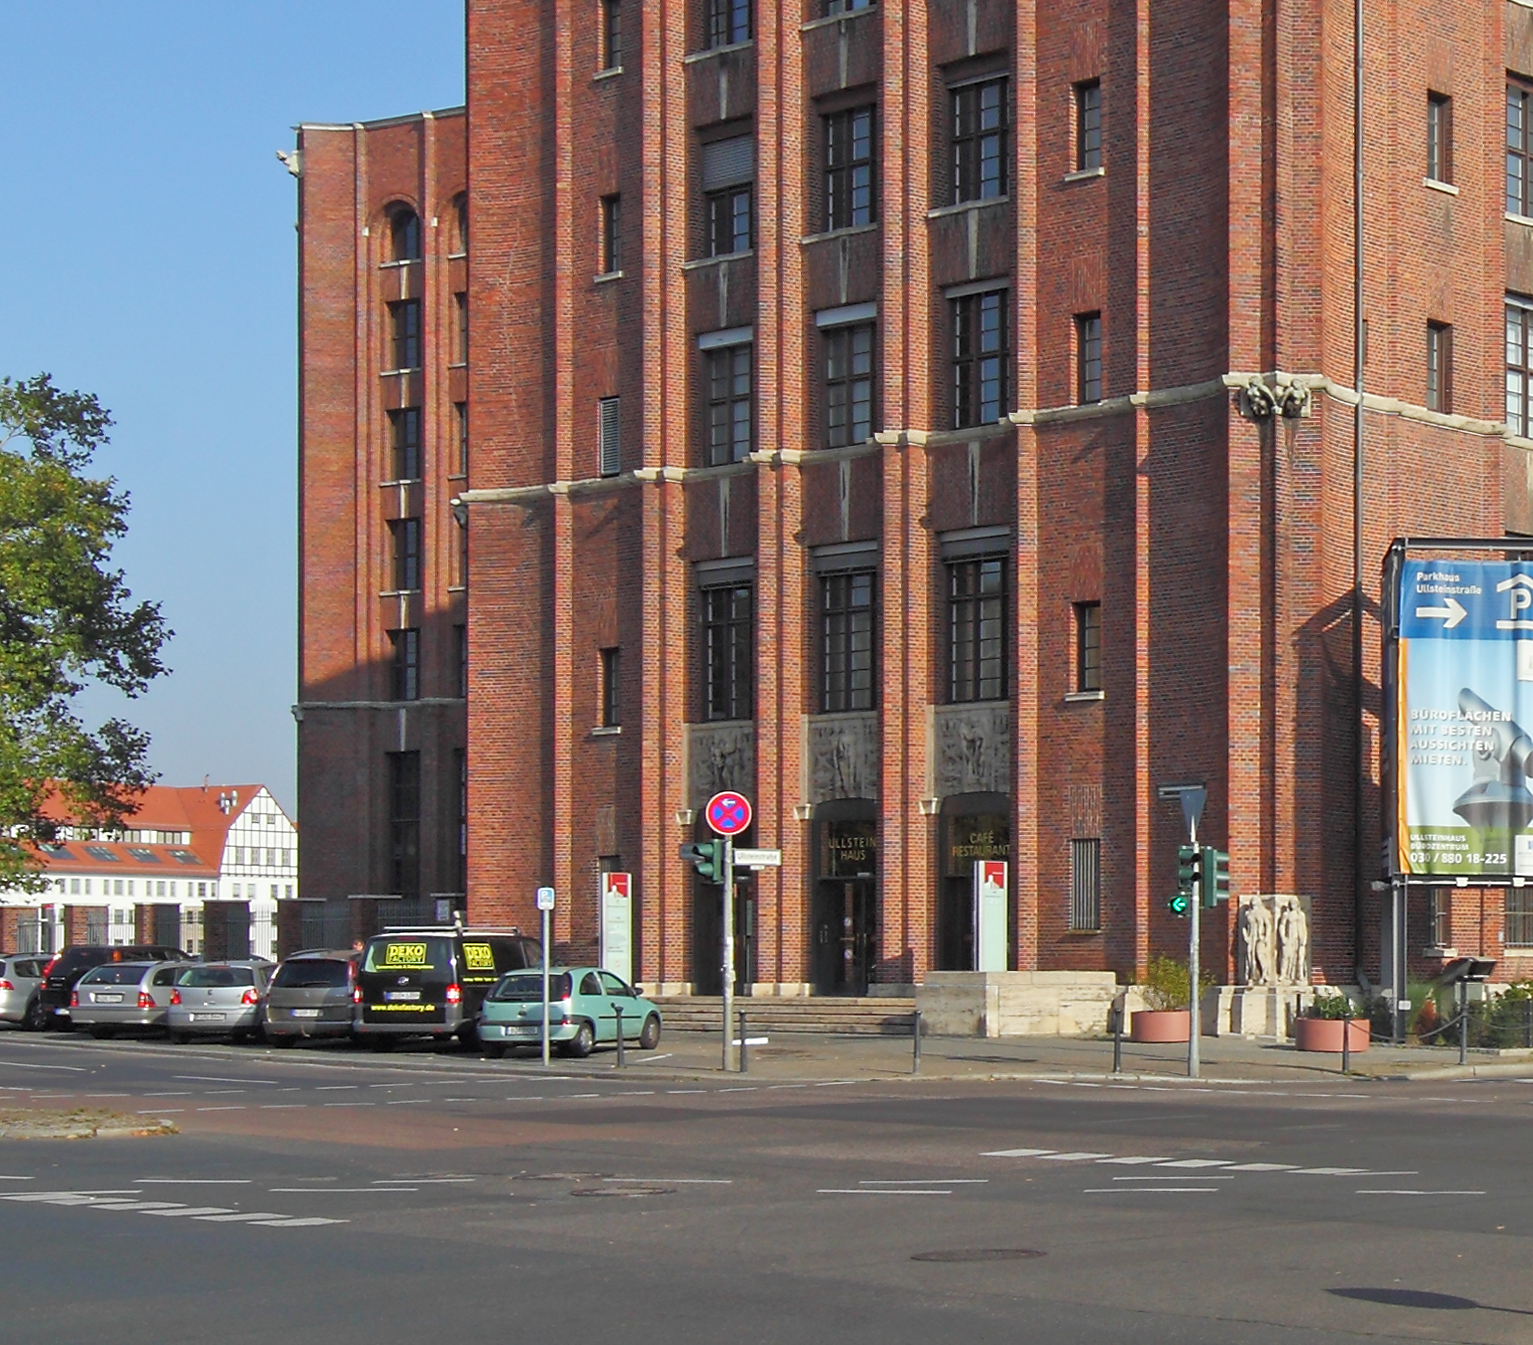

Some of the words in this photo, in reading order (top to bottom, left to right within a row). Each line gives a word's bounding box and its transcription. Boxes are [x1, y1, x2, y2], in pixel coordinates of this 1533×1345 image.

[1416, 572, 1460, 582] Parkhaus
[1416, 584, 1482, 594] Ullsteinstraße
[1411, 707, 1512, 722] BÜROFLÄCHEN
[1411, 725, 1437, 736] MIT
[1442, 725, 1493, 737] BESTEN
[1411, 740, 1495, 751] AUSSICHTEN
[1411, 754, 1468, 766] MIETEN.
[969, 830, 995, 844] CAFÉ
[1410, 834, 1466, 842] ULLSTEINHAUS
[828, 838, 876, 849] ULLSTEIN
[1410, 843, 1470, 851] BÜROZENTRUM
[840, 850, 866, 861] HAUS
[952, 844, 1010, 857] RESTAURANT
[1410, 853, 1430, 864] 030
[1441, 854, 1463, 864] 880
[1466, 854, 1508, 864] 18-225
[389, 945, 424, 956] DEKO
[465, 946, 491, 959] DEKO
[389, 955, 423, 963] FACTORY
[469, 958, 493, 967] FACTORY
[371, 1004, 435, 1012] www.dekofactory.de
